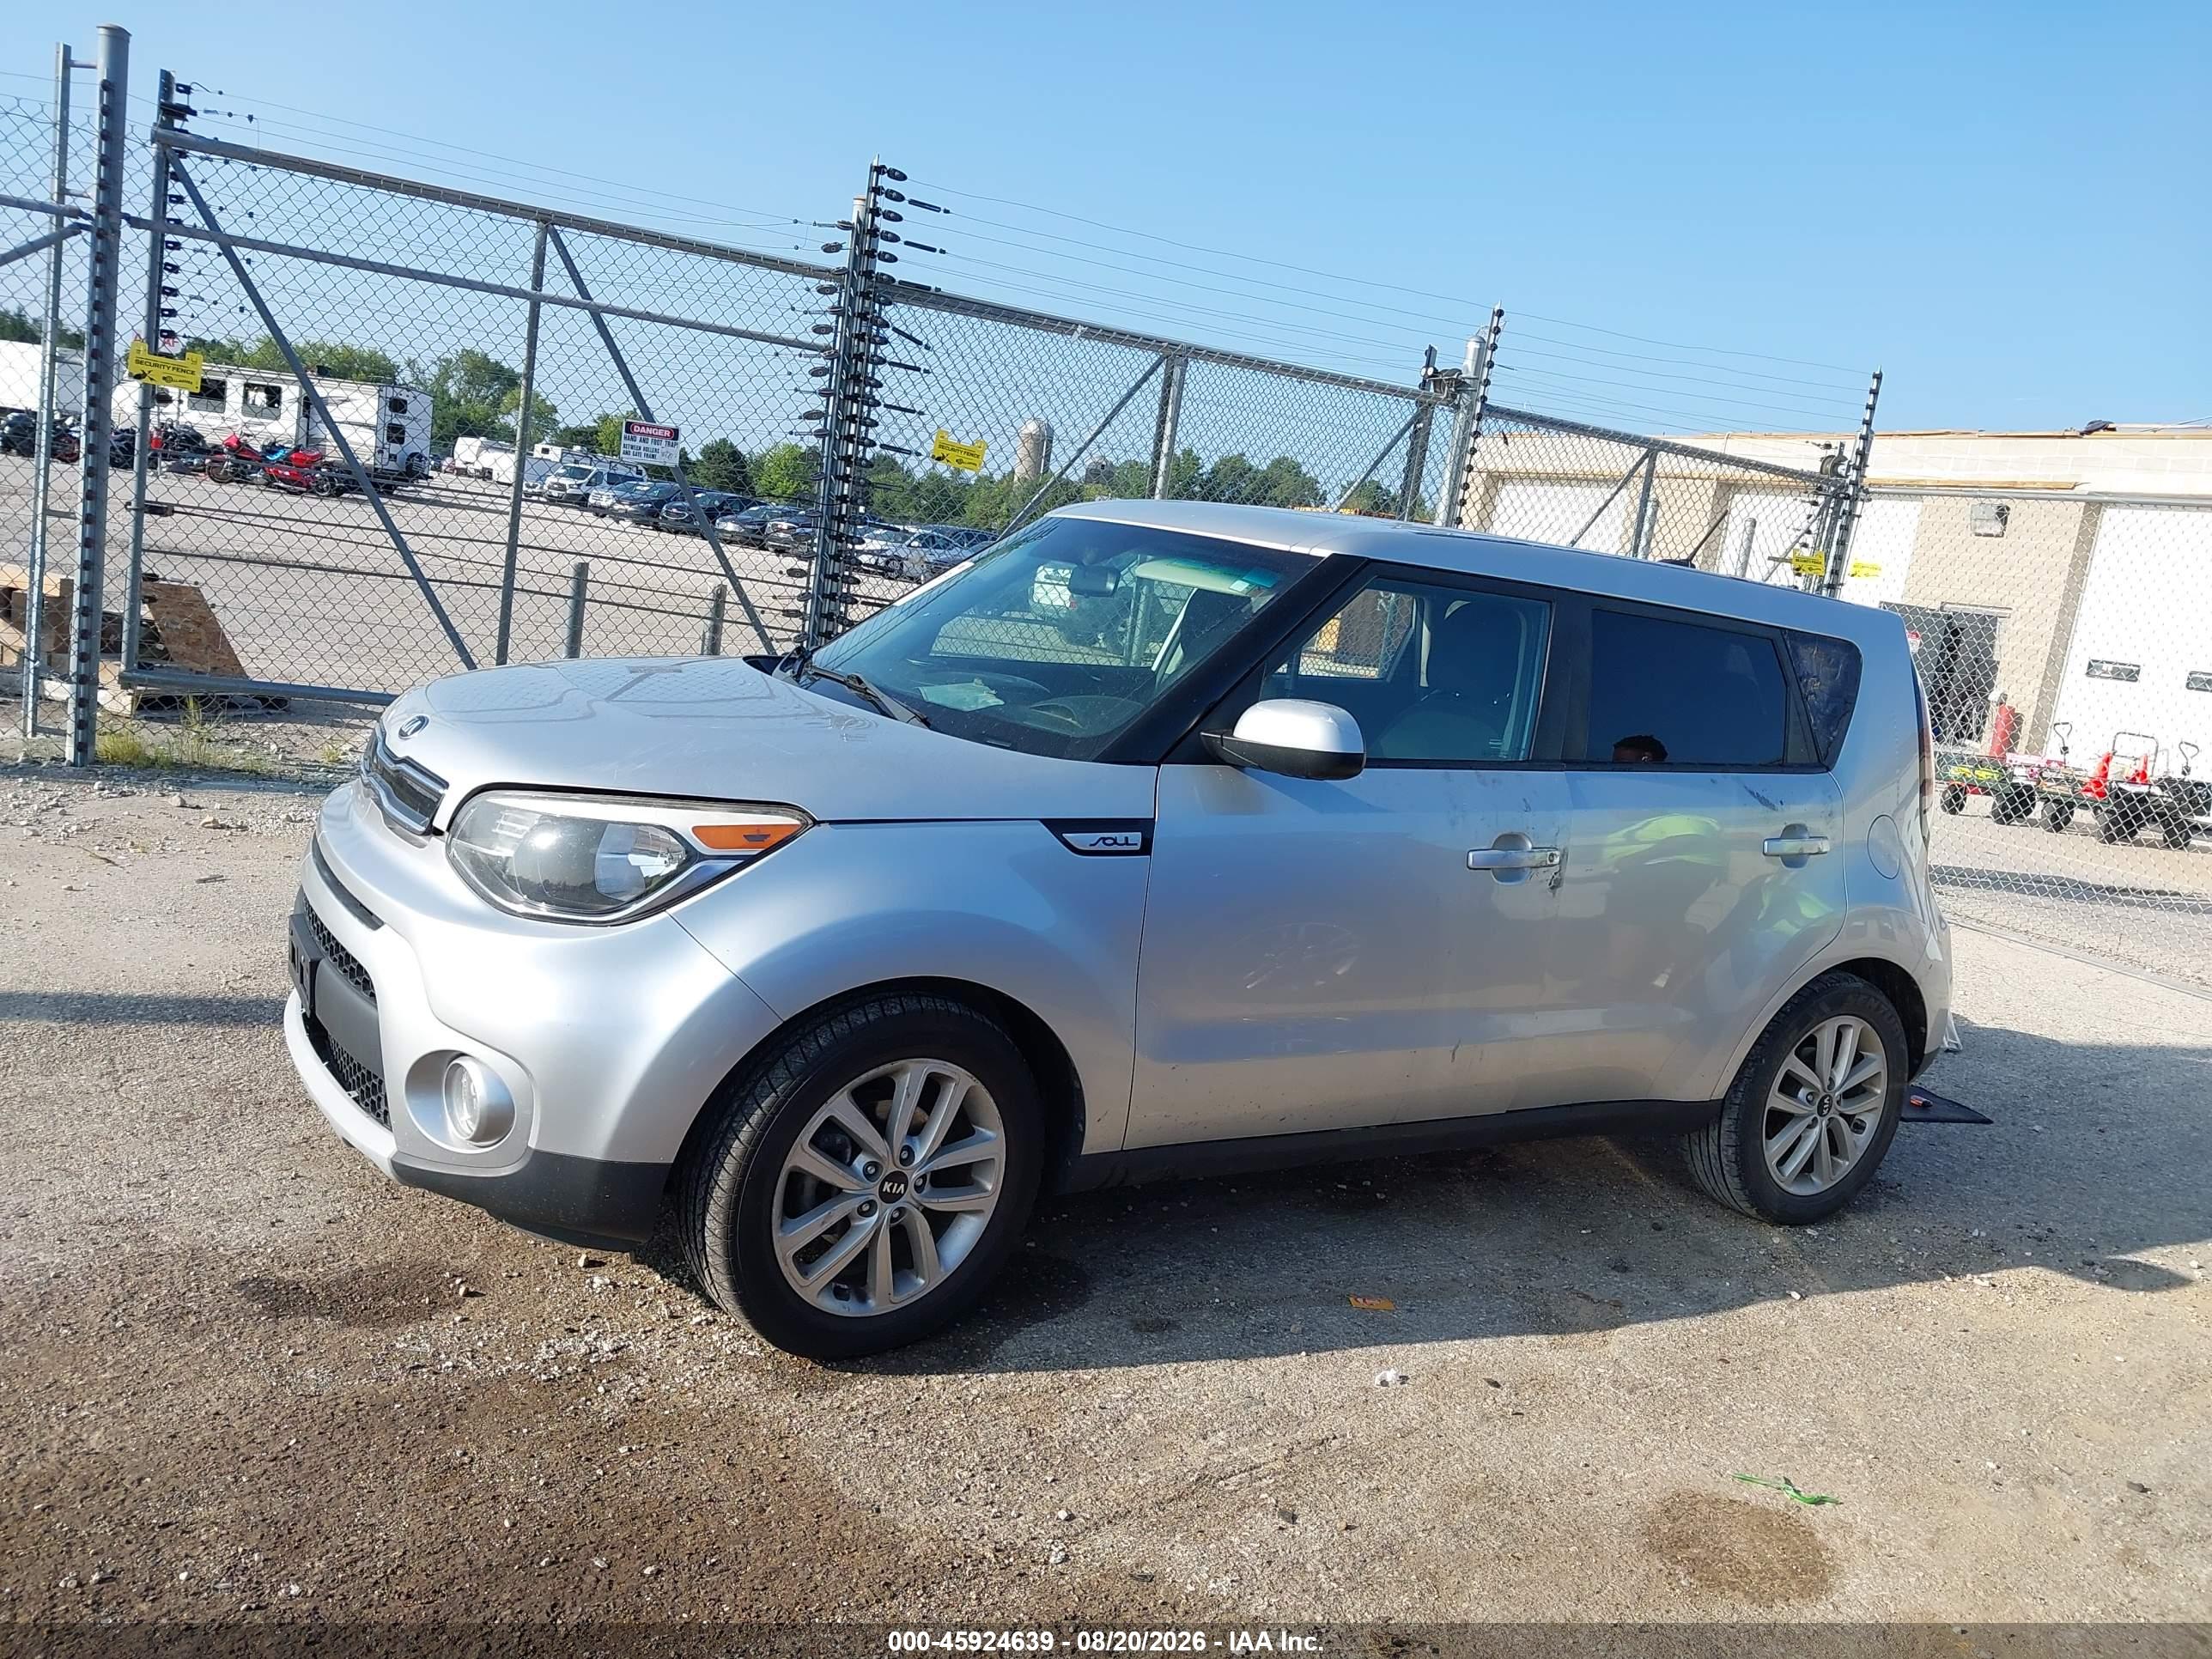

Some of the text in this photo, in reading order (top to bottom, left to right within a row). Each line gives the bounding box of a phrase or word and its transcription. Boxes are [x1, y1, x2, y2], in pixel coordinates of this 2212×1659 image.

[135, 359, 196, 375] SECURITY FENCE
[633, 425, 671, 437] DANGER
[939, 444, 963, 455] SECURITY
[1089, 836, 1138, 847] SOUL
[882, 1181, 905, 1194] KIA
